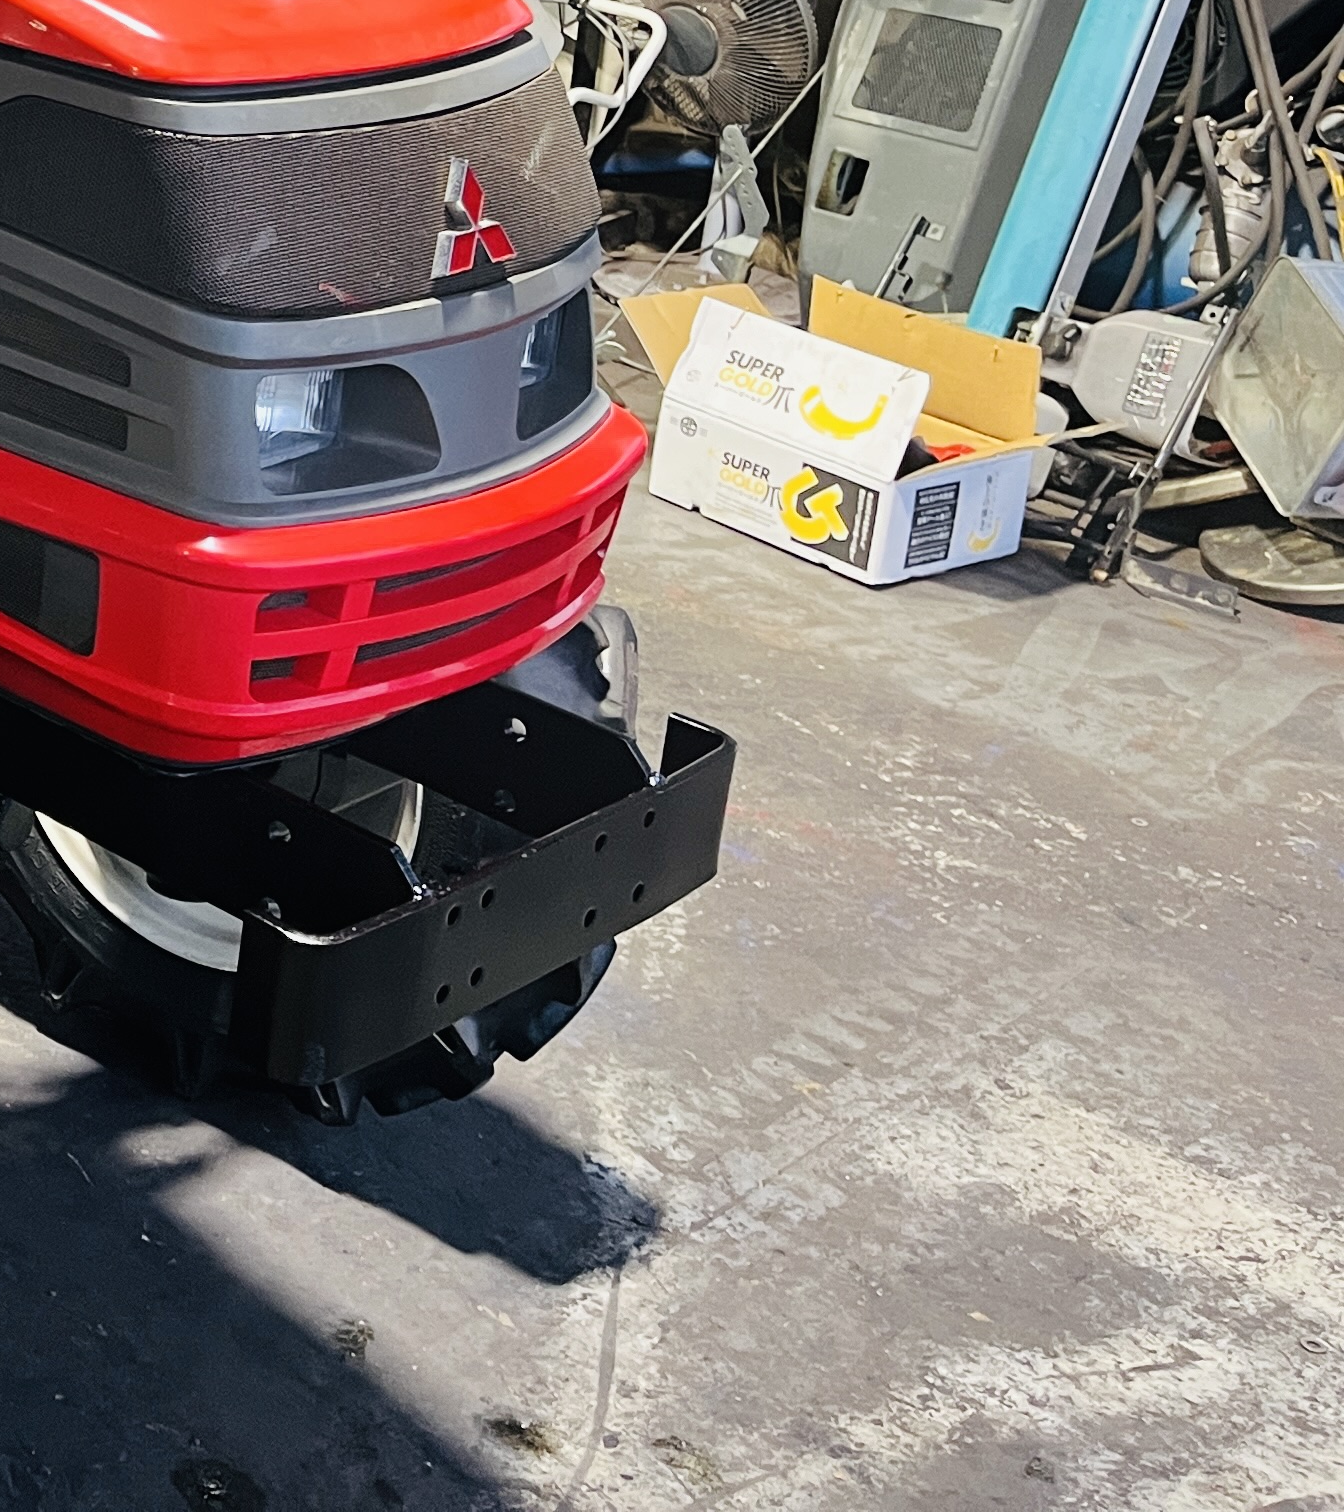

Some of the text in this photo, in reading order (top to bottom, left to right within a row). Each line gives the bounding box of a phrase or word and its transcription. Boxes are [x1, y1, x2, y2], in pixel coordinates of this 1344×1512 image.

[718, 366, 774, 398] GOLD
[725, 349, 786, 383] SUPER
[721, 451, 771, 482] SUPER
